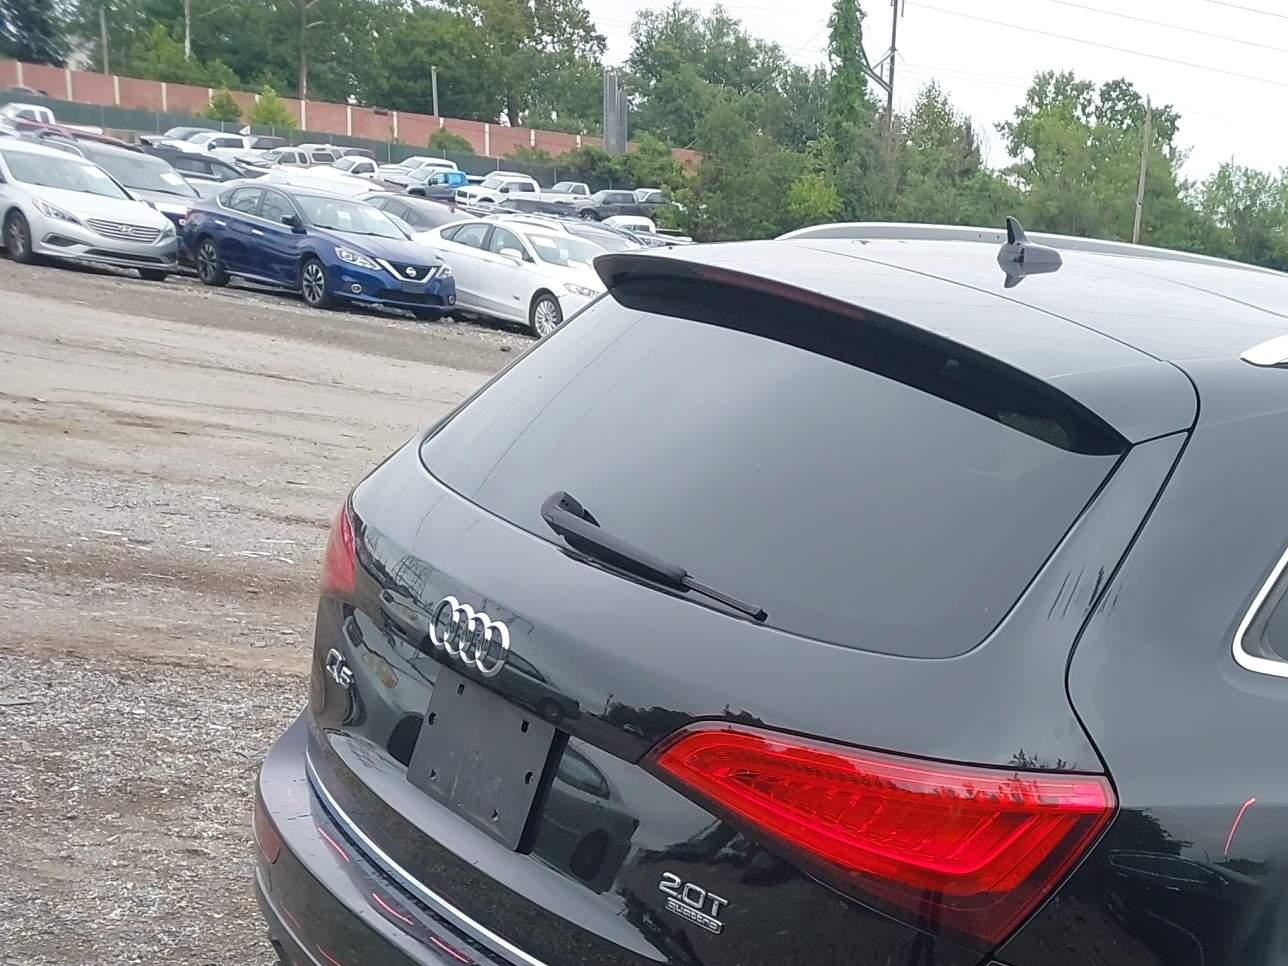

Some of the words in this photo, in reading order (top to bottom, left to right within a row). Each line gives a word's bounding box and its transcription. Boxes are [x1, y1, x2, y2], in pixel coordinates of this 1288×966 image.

[325, 648, 354, 689] Q5
[658, 872, 729, 917] 2.0T
[666, 899, 721, 933] quattro
